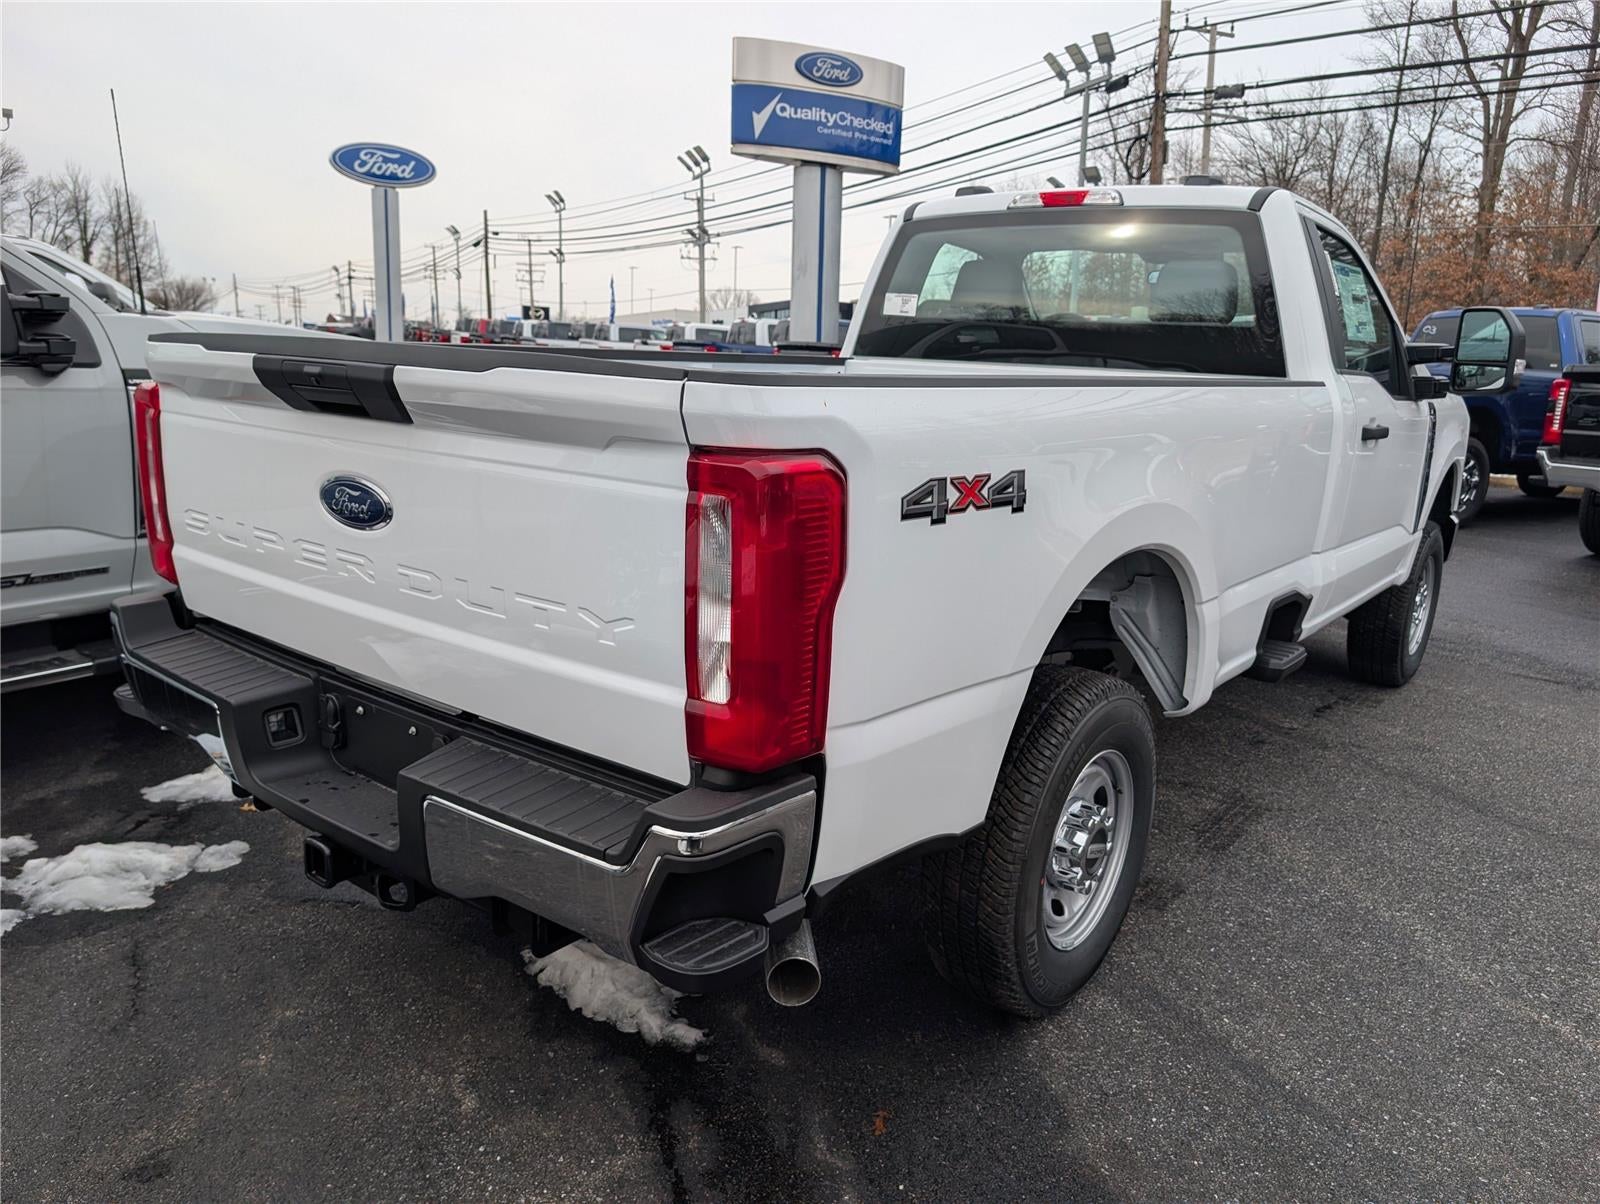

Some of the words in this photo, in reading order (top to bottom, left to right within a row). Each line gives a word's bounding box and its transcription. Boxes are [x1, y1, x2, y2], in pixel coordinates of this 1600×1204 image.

[812, 57, 851, 82] Ford
[816, 125, 853, 139] Certified
[854, 131, 893, 146] Pre-owned
[353, 148, 416, 179] Ford
[331, 486, 372, 520] Ford
[184, 507, 377, 585] SUPER
[396, 562, 636, 646] DUTY
